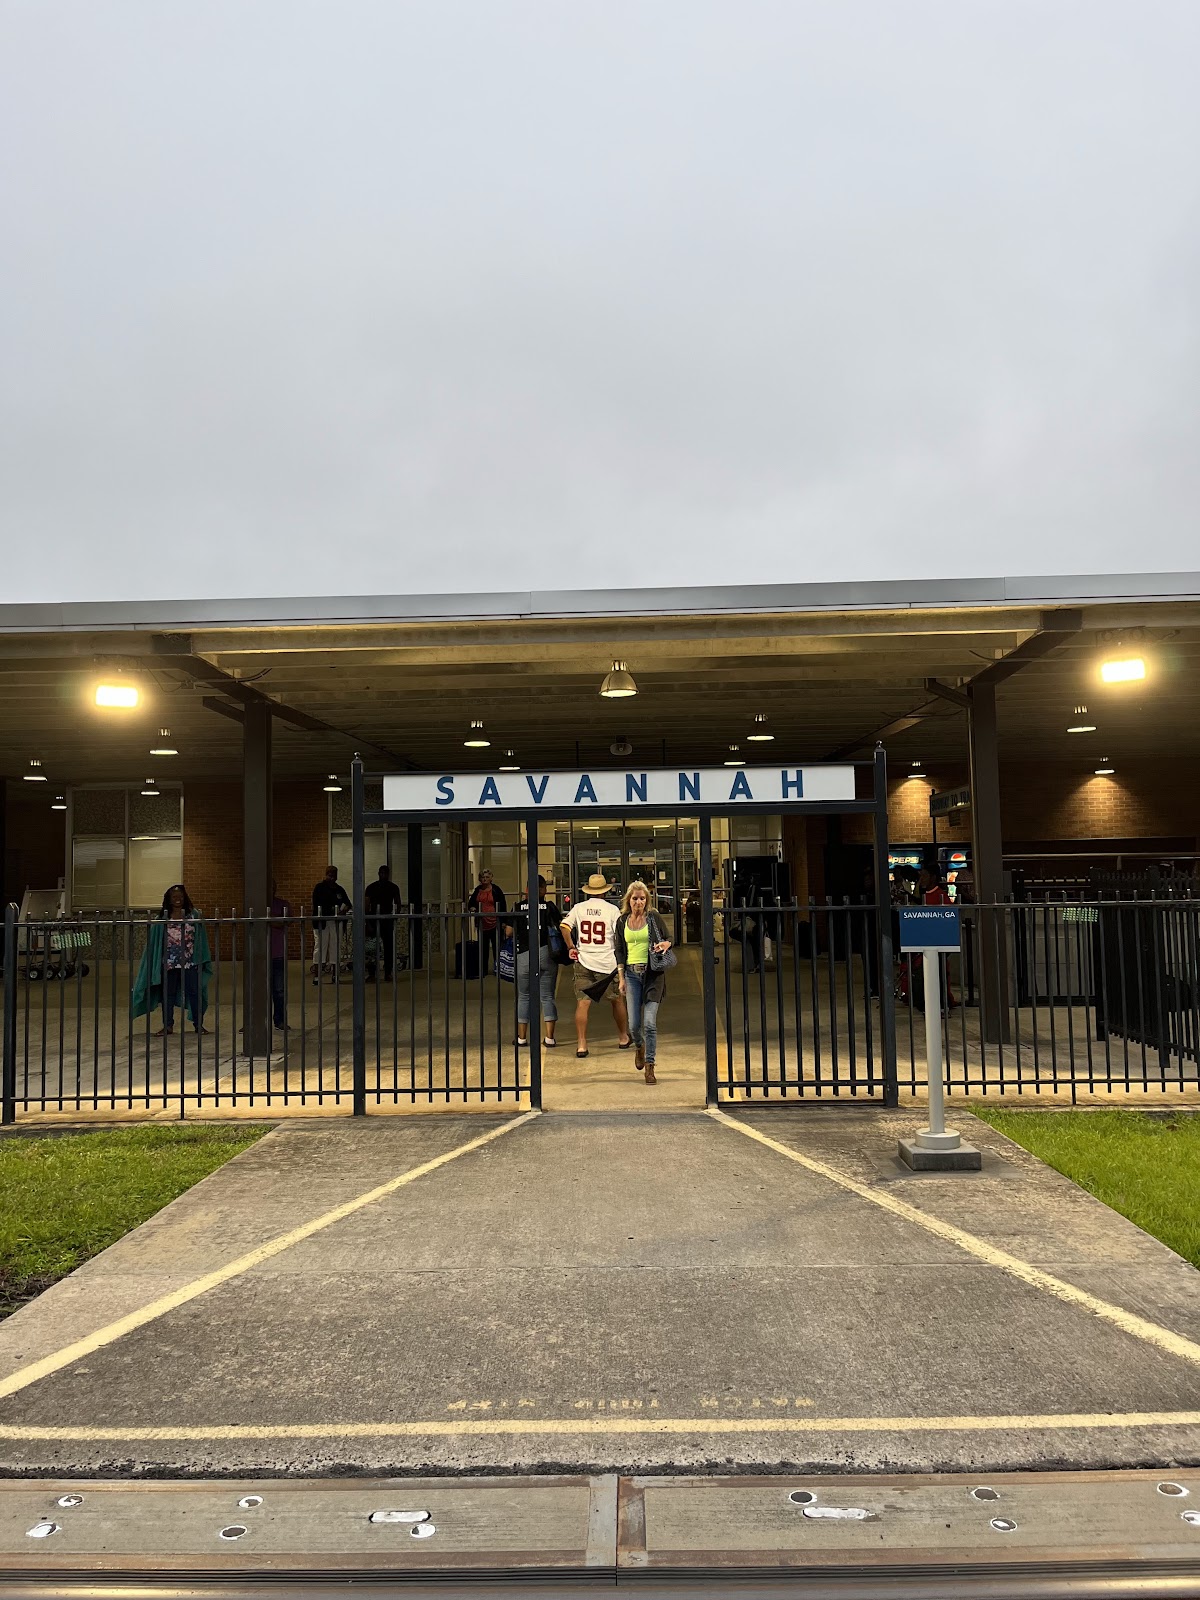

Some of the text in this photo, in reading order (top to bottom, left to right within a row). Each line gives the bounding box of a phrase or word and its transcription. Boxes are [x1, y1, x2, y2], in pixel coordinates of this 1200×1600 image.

[435, 769, 804, 805] SAVANNAH
[892, 856, 920, 864] PEPSI
[580, 920, 606, 945] 99
